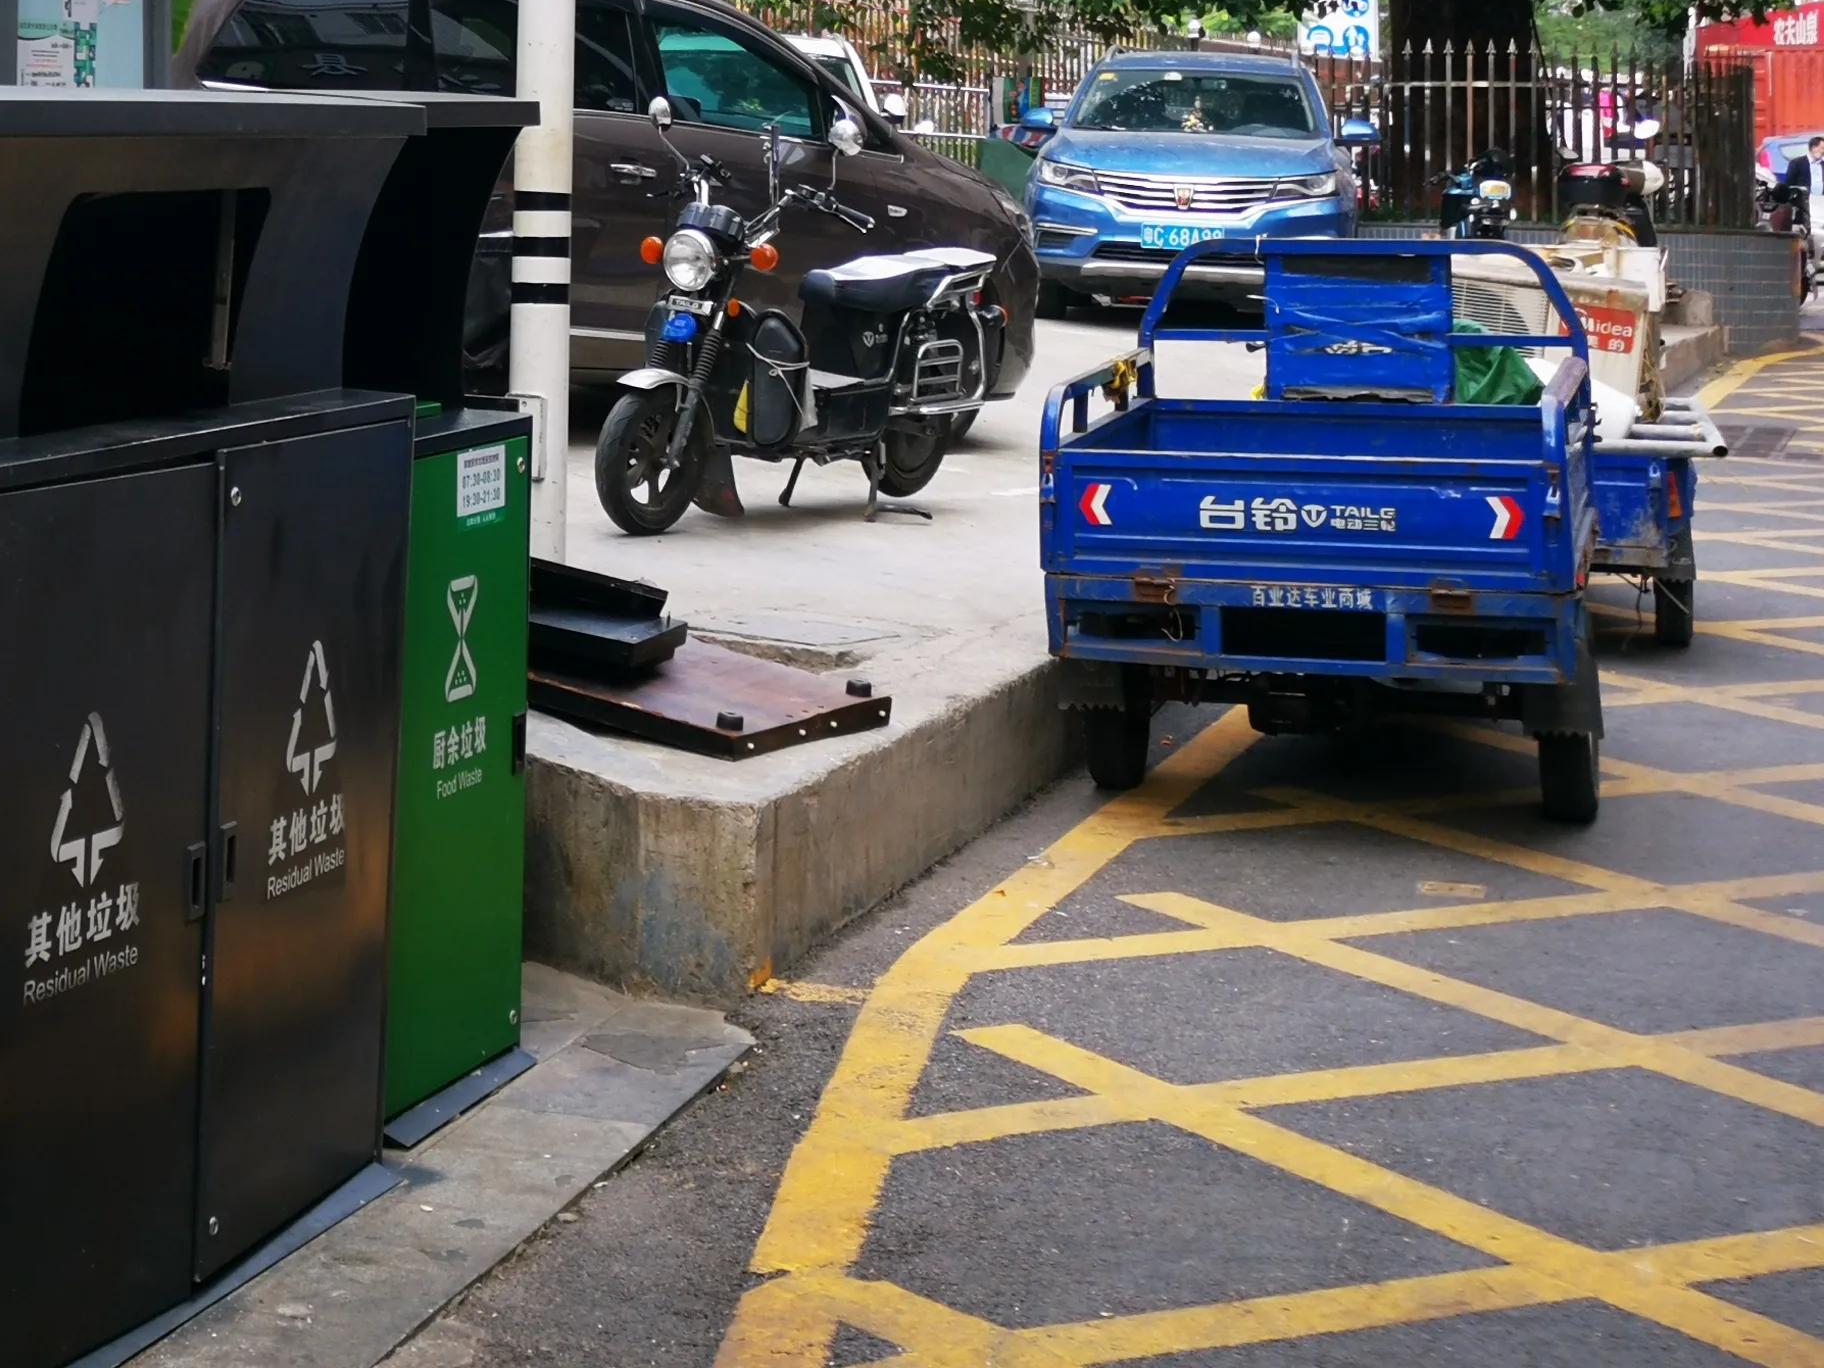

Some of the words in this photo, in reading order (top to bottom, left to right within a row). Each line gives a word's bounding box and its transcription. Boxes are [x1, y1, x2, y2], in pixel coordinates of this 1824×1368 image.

[1773, 9, 1818, 45] 农夫山泉
[1580, 315, 1633, 337] Midea
[1199, 495, 1297, 531] 台铃
[1330, 505, 1396, 519] TAILG
[433, 716, 486, 769] 厨余垃圾
[436, 774, 457, 800] Food
[457, 768, 483, 790] Waste
[268, 793, 345, 866] 其他垃圾
[267, 858, 313, 900] Residual
[314, 848, 345, 877] Waste
[24, 882, 140, 968] 其他垃圾
[23, 958, 90, 1006] Residual
[93, 945, 138, 979] Waste
